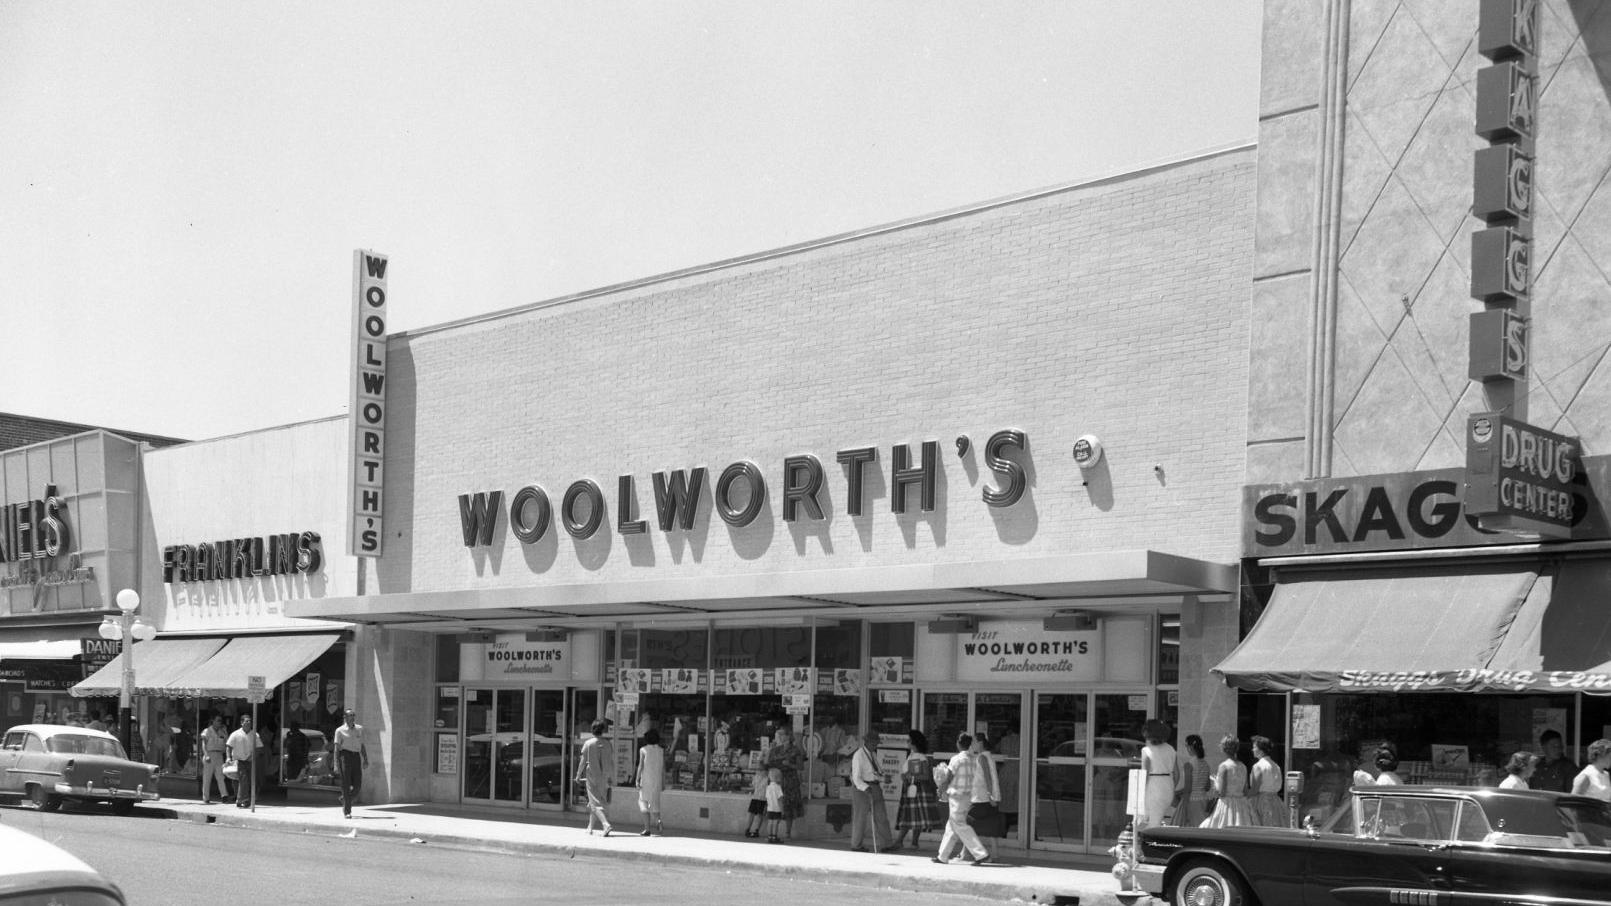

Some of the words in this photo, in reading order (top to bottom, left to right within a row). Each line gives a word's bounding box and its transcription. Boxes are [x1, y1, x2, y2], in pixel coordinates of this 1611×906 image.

[362, 255, 387, 552] WOOLWORTH'S
[1501, 424, 1575, 483] DRUG
[458, 428, 1027, 549] WOOLWORTH'S
[1500, 477, 1573, 520] CENTER
[1255, 473, 1588, 547] SKAG
[971, 631, 999, 641] VISIT
[488, 649, 562, 661] WOOLWORTH'S
[964, 641, 1089, 656] WOOLWORTH'S
[504, 662, 553, 674] Luncheonette
[990, 657, 1073, 672] Luncheonette
[1339, 669, 1447, 690] Skaggs
[1454, 668, 1537, 690] Drug
